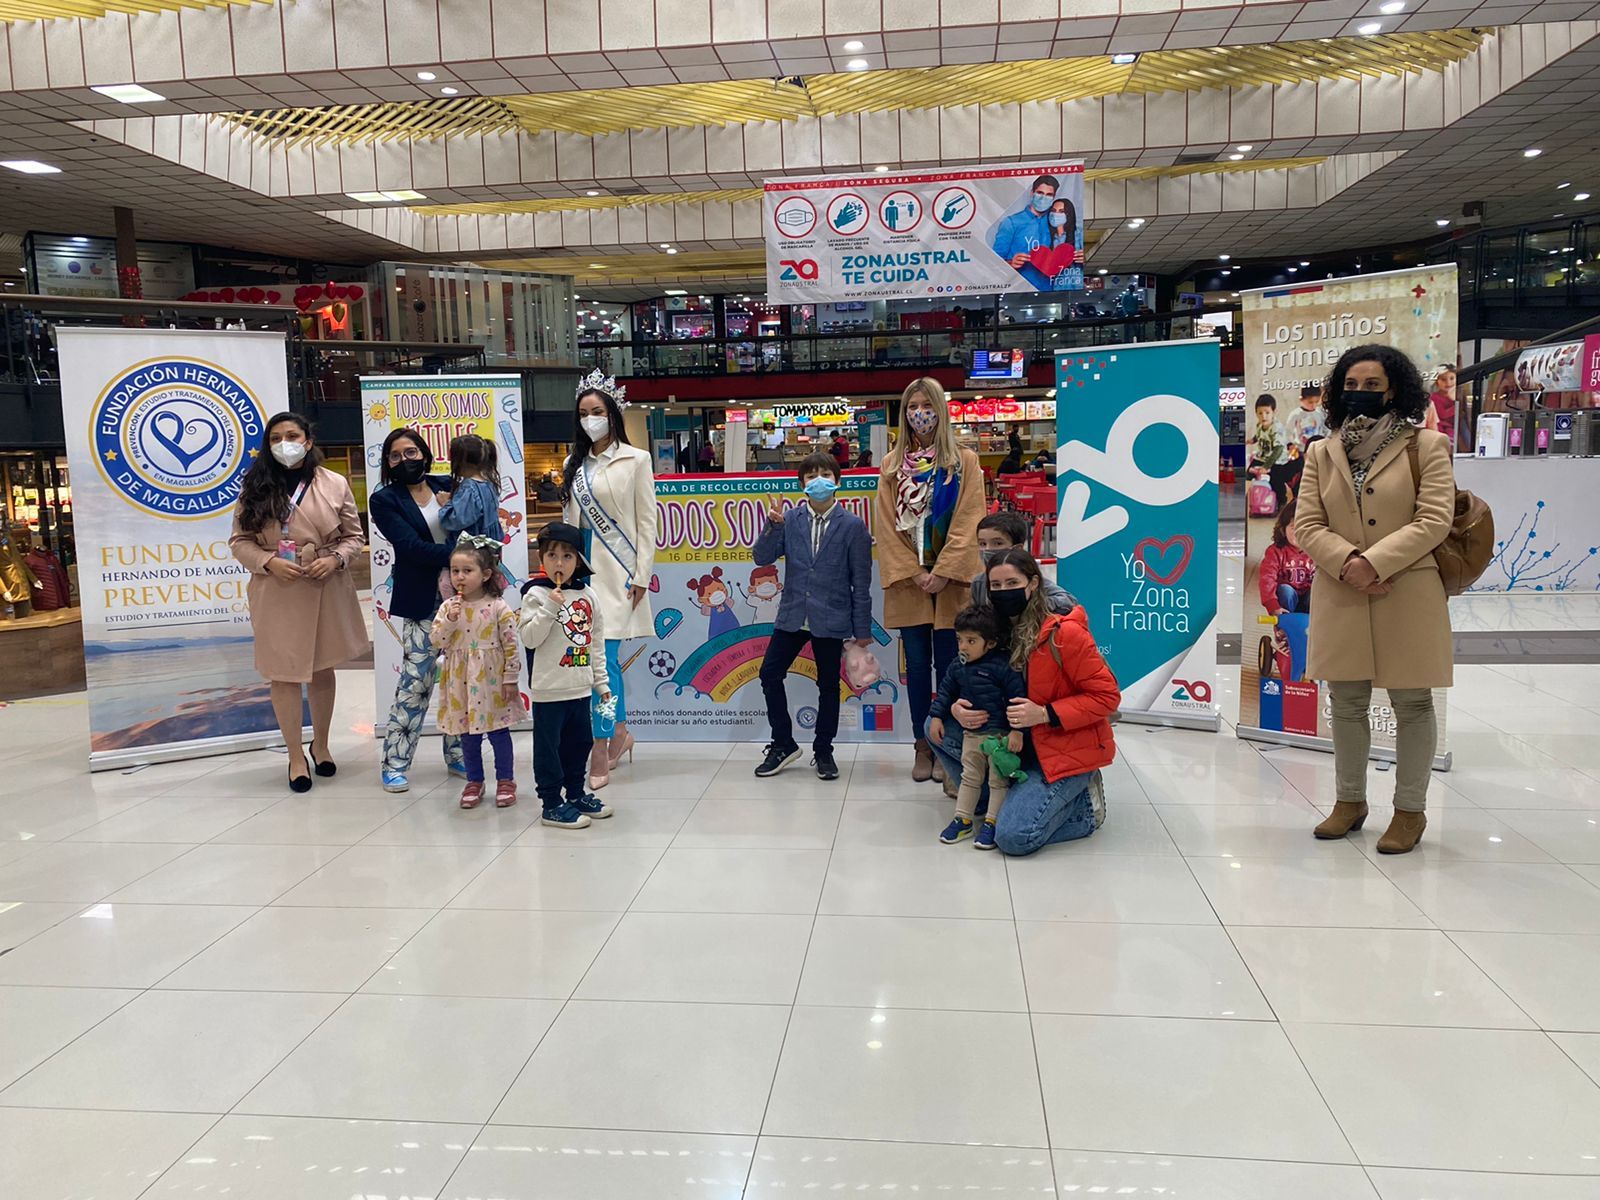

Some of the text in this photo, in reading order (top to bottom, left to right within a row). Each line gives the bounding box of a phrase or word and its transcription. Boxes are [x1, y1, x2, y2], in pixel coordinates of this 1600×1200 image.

[873, 176, 910, 184] SEGURA
[1041, 165, 1079, 173] SEGURA
[1024, 235, 1040, 252] Yo
[842, 249, 971, 269] ZONAUSTRAL
[842, 268, 929, 285] TE CUIDA
[1050, 275, 1081, 286] Franca
[1057, 265, 1081, 277] Zona
[779, 280, 819, 288] ZONAUSTRAL
[1263, 313, 1388, 345] Los niños
[1263, 345, 1351, 375] prime
[102, 366, 259, 436] FUNDACIÓN HERNANDO
[139, 392, 168, 413] ESTUDIO
[174, 390, 223, 415] TRATAMIENTO
[393, 391, 490, 419] TODOS SOMOS
[772, 402, 848, 418] TOMMYBEANS
[220, 414, 231, 428] DEL
[225, 428, 235, 458] CÁNCER
[116, 471, 143, 496] DE
[153, 471, 217, 487] EN MAGALLANES
[681, 484, 696, 493] DE
[700, 481, 779, 492] RECOLECCIÓN
[783, 481, 798, 490] DE
[846, 480, 877, 489] ESCO
[588, 506, 611, 534] CHILE
[655, 500, 718, 548] ODOS
[101, 540, 233, 567] FUNDAC
[669, 551, 754, 562] 16 DE FEBRER
[102, 565, 251, 583] HERNANDO DE MAGAL
[1120, 552, 1146, 579] Yo
[104, 579, 250, 609] PREVENCI
[1131, 580, 1190, 609] Zona
[105, 613, 143, 623] ESTUDIO
[144, 612, 151, 620] Y
[153, 608, 212, 620] TRATAMIENTO
[214, 607, 229, 615] DEL
[1110, 603, 1190, 633] Franca
[625, 709, 651, 717] uchos
[652, 709, 675, 717] niños
[676, 709, 713, 717] donando
[714, 709, 737, 717] útiles
[1171, 700, 1211, 710] ZONAUSTRAL
[709, 718, 755, 726] estudiantil.
